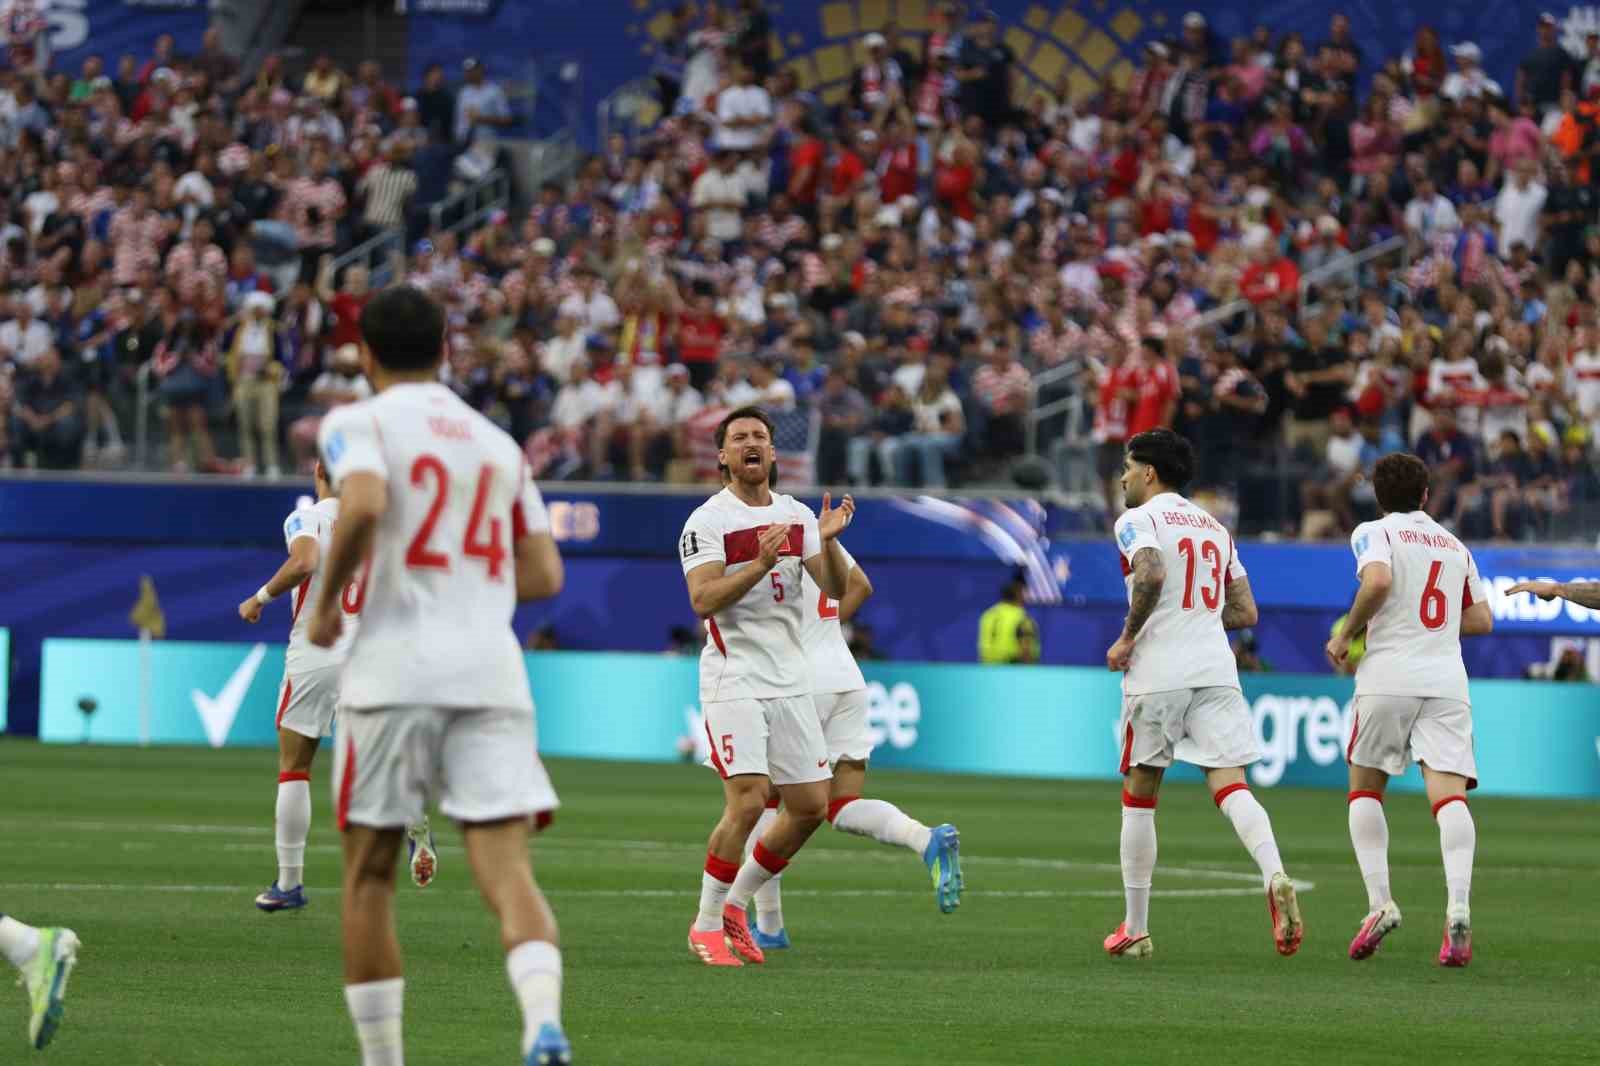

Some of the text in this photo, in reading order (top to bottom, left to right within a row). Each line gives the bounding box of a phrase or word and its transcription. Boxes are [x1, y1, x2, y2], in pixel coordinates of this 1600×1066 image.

[405, 453, 506, 583] 24
[770, 572, 784, 602] 5
[1177, 537, 1222, 612] 13
[1419, 560, 1448, 632] 6
[721, 733, 735, 766] 5
